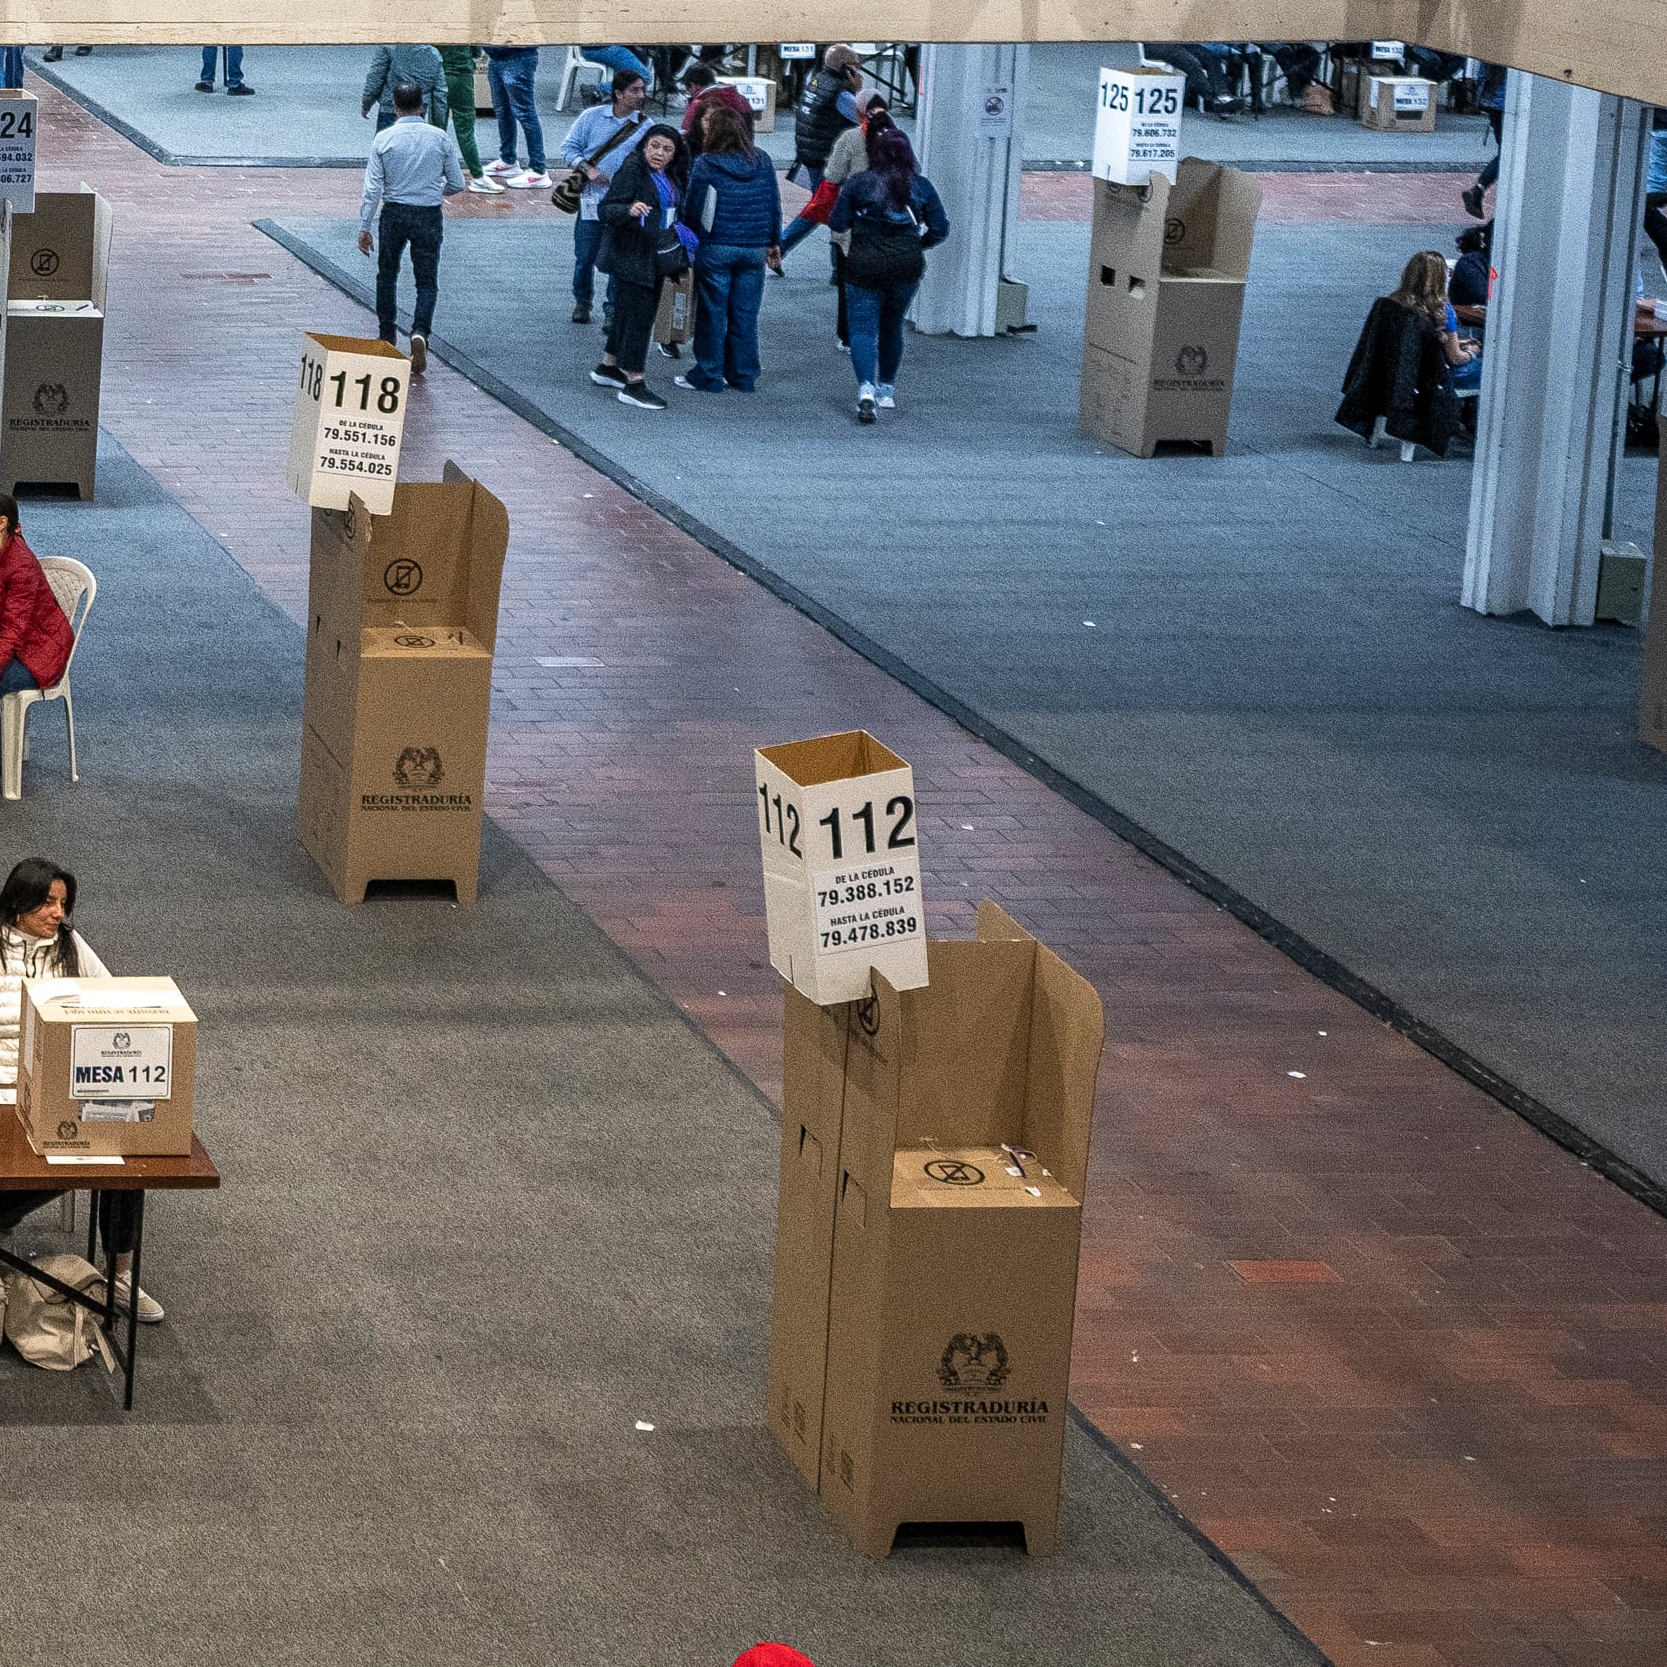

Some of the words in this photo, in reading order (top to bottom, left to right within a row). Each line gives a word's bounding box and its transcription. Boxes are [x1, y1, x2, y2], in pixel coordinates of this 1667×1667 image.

[1101, 81, 1129, 113] 125
[1135, 87, 1178, 115] 125
[299, 353, 323, 402] 118
[329, 370, 401, 415] 118
[338, 419, 348, 427] DE
[348, 420, 358, 428] LA
[323, 427, 396, 447] 79.551.156
[328, 447, 349, 456] HASTA
[349, 449, 359, 457] LA
[320, 455, 392, 476] 79.554.025
[361, 793, 473, 806] REGISTRADURÍA
[758, 783, 803, 862] 112
[818, 795, 916, 861] 112
[834, 875, 848, 886] DE
[850, 873, 862, 884] LA
[863, 866, 896, 882] CÉDULA
[817, 876, 916, 909] 79.388.152
[829, 916, 858, 929] HASTA
[859, 913, 871, 924] LA
[872, 906, 906, 922] CÉDULA
[819, 917, 917, 949] 79.478.839
[75, 1065, 124, 1084] MESA
[128, 1065, 166, 1083] 112
[890, 1397, 1050, 1415] REGISTRADURÍA
[890, 1416, 942, 1424] NACIONAL
[947, 1416, 968, 1424] DEL
[972, 1416, 1016, 1424] ESTADO
[1018, 1416, 1048, 1424] CIVIL
